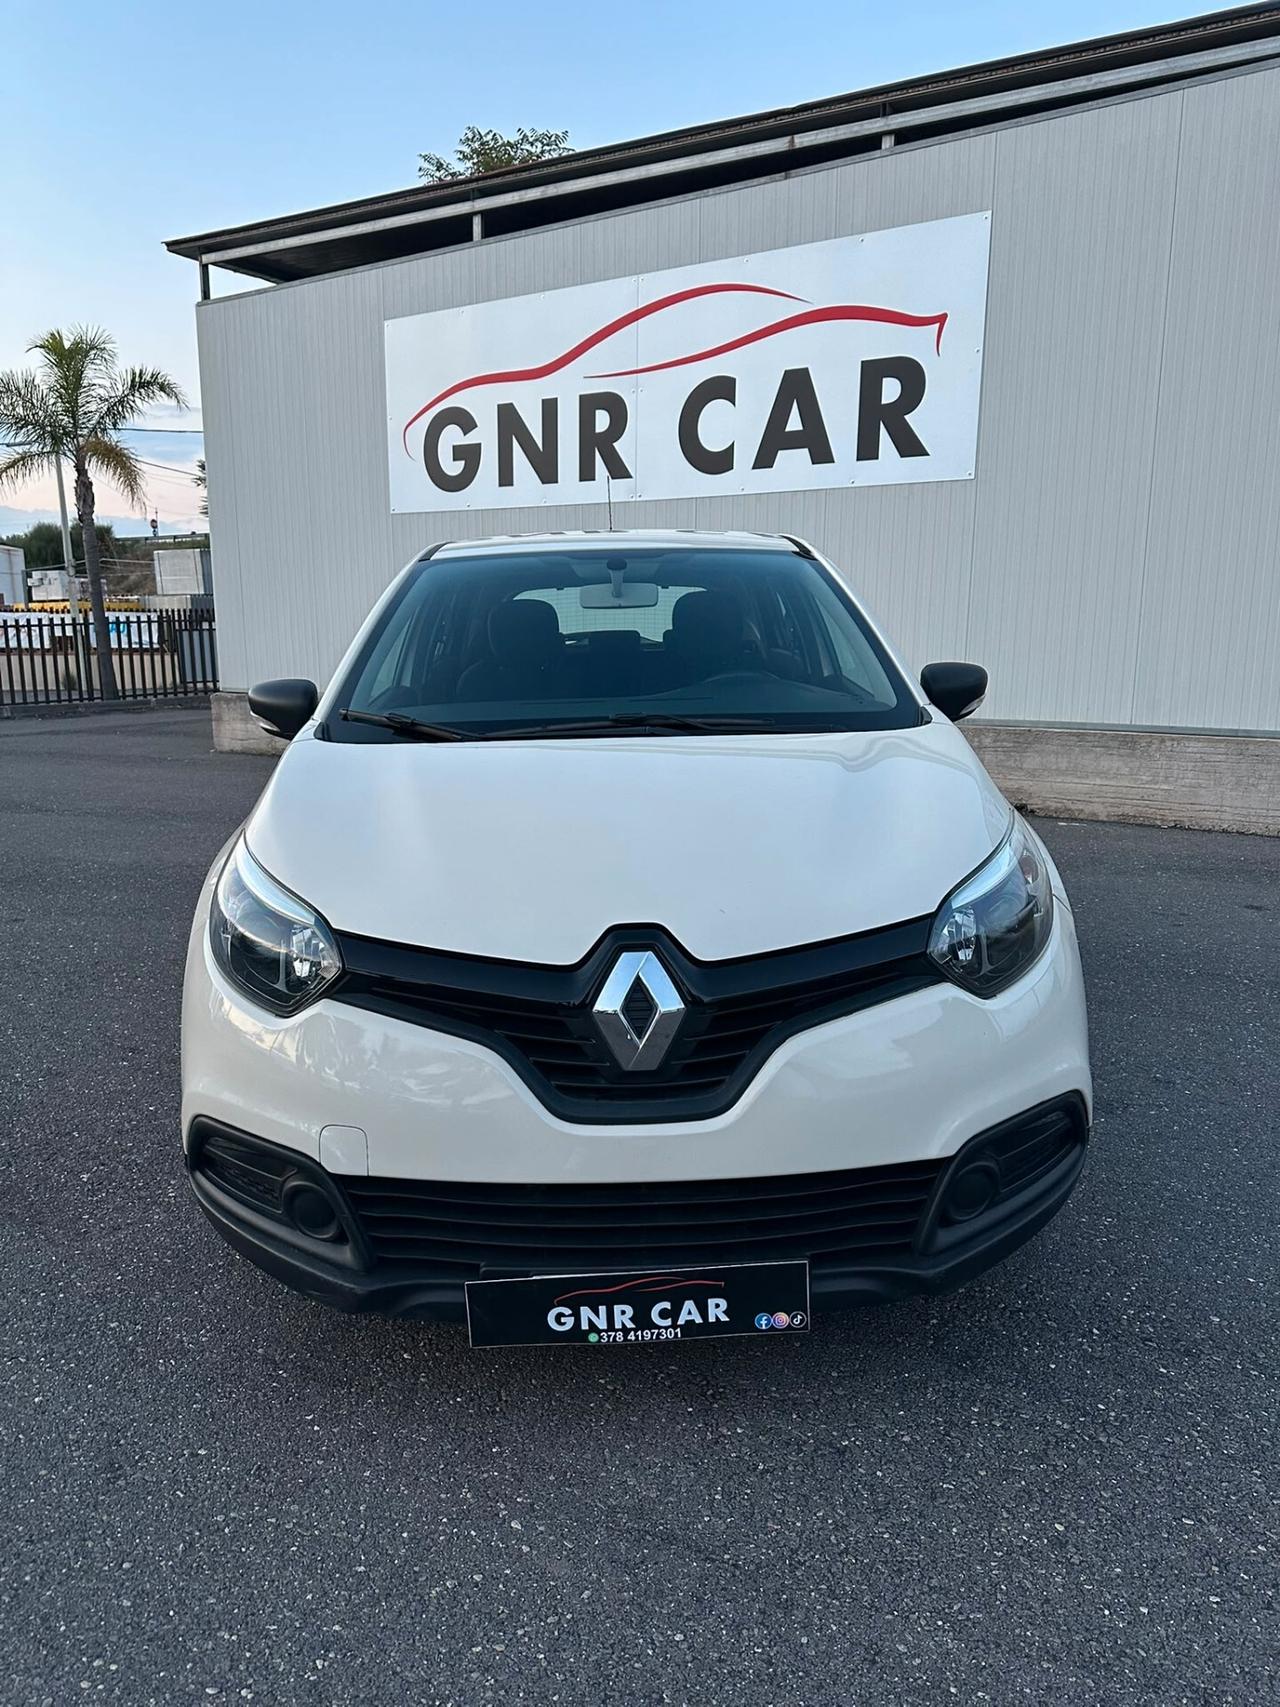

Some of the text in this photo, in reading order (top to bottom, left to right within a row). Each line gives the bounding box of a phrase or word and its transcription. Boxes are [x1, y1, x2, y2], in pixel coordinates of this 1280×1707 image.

[423, 356, 931, 493] GNR CAR
[547, 1298, 730, 1332] GNR CAR
[600, 1328, 682, 1343] 378 4197301
